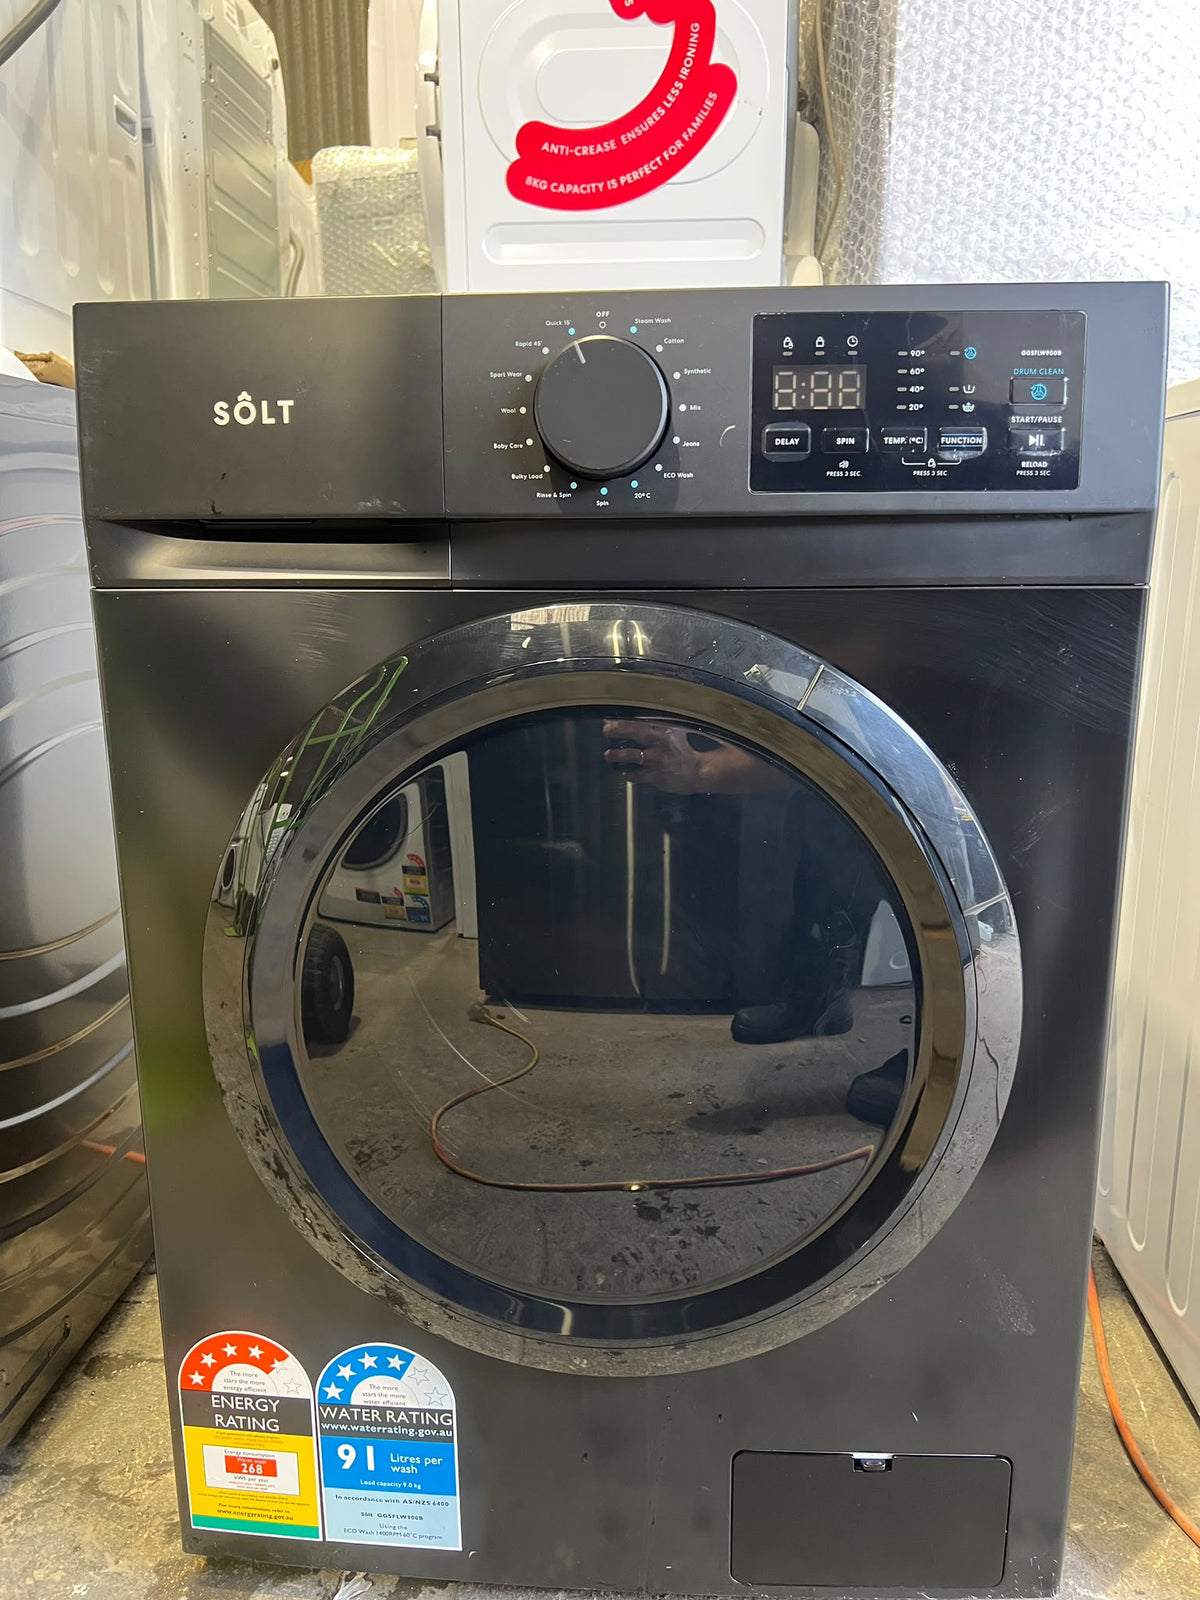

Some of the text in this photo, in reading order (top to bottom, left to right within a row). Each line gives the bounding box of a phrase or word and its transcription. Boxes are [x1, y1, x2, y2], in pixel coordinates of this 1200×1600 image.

[541, 22, 700, 157] ANTI-CREASE ENSURES LESS IRONING
[525, 92, 718, 194] 8KG CAPACITY IS PERFECT FOR FAMILIES
[214, 391, 294, 425] SÔLT
[211, 1395, 280, 1413] ENERGY
[215, 1414, 280, 1432] RATING
[320, 1406, 452, 1426] WATER RATING
[321, 1423, 452, 1437] www.waterrating.gov.au
[242, 1450, 276, 1459] consumption
[390, 1452, 420, 1464] Litres
[424, 1457, 443, 1466] per
[241, 1463, 263, 1474] 268
[391, 1465, 418, 1474] wash
[217, 1509, 294, 1520] www.energyrating.gov.au
